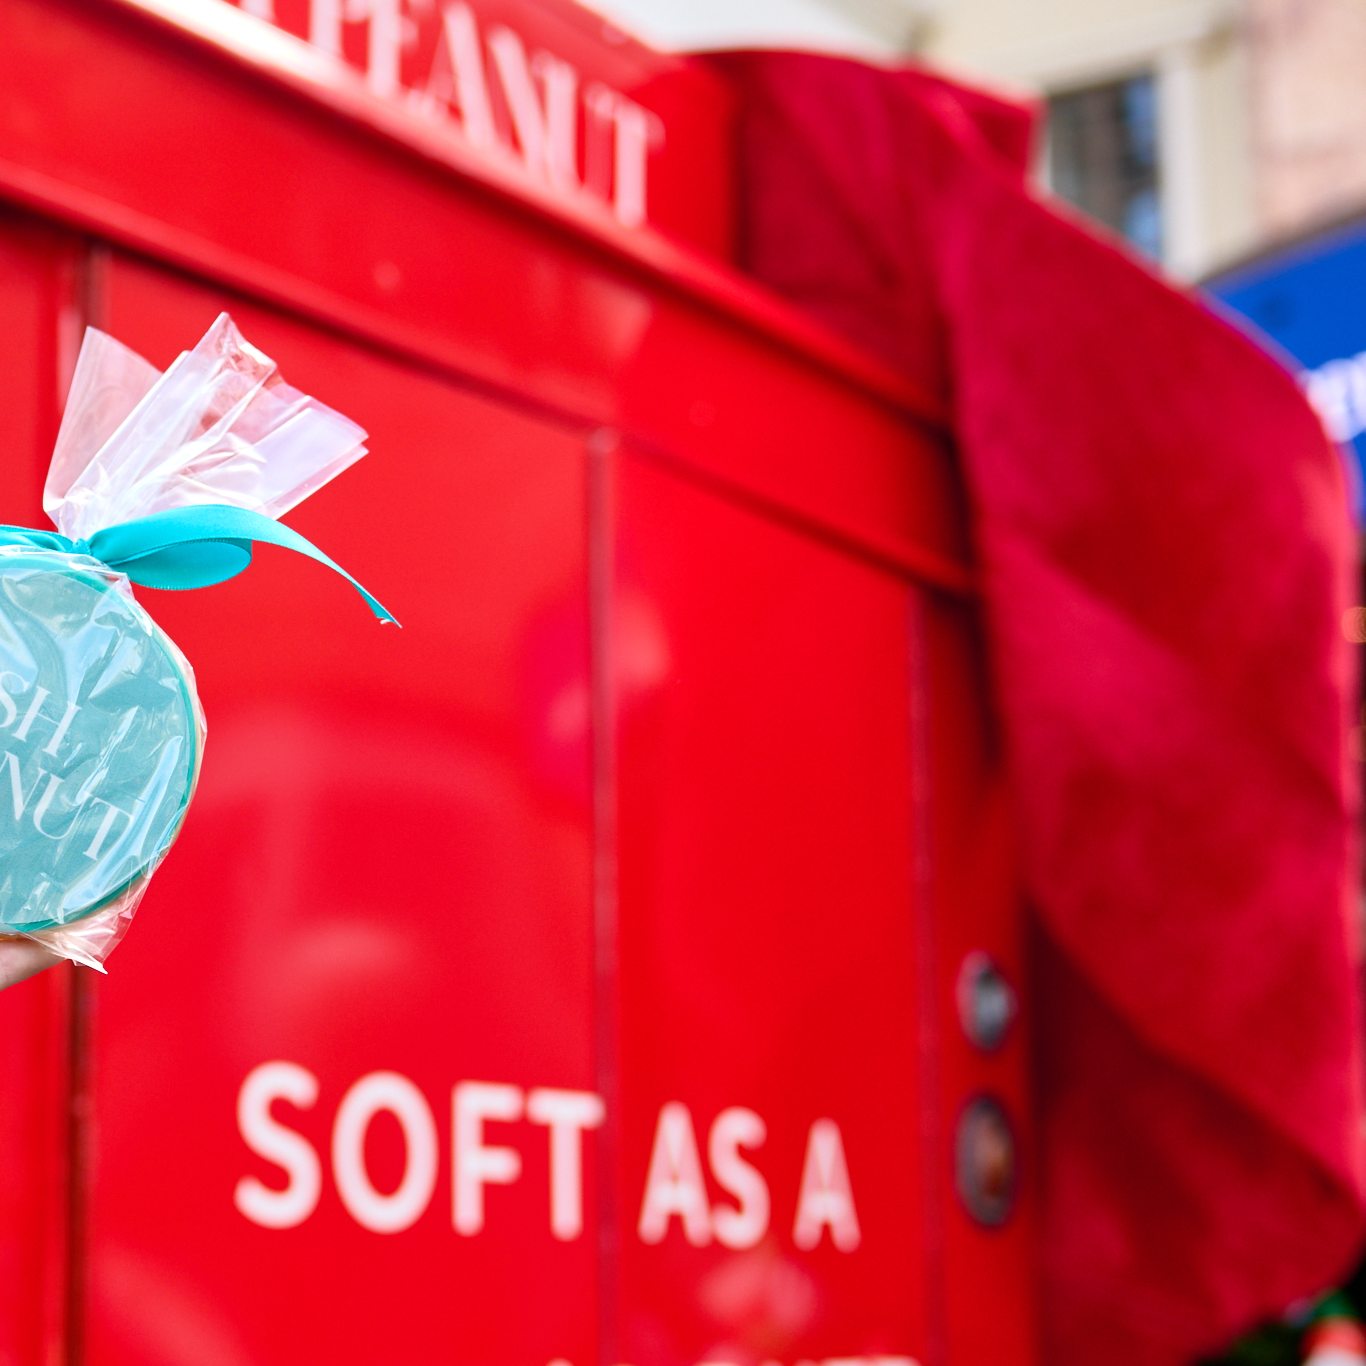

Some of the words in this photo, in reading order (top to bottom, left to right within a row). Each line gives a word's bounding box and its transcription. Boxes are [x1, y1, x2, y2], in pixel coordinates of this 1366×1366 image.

[235, 1061, 605, 1240] SOFT
[638, 1102, 771, 1247] AS
[792, 1118, 862, 1252] A
